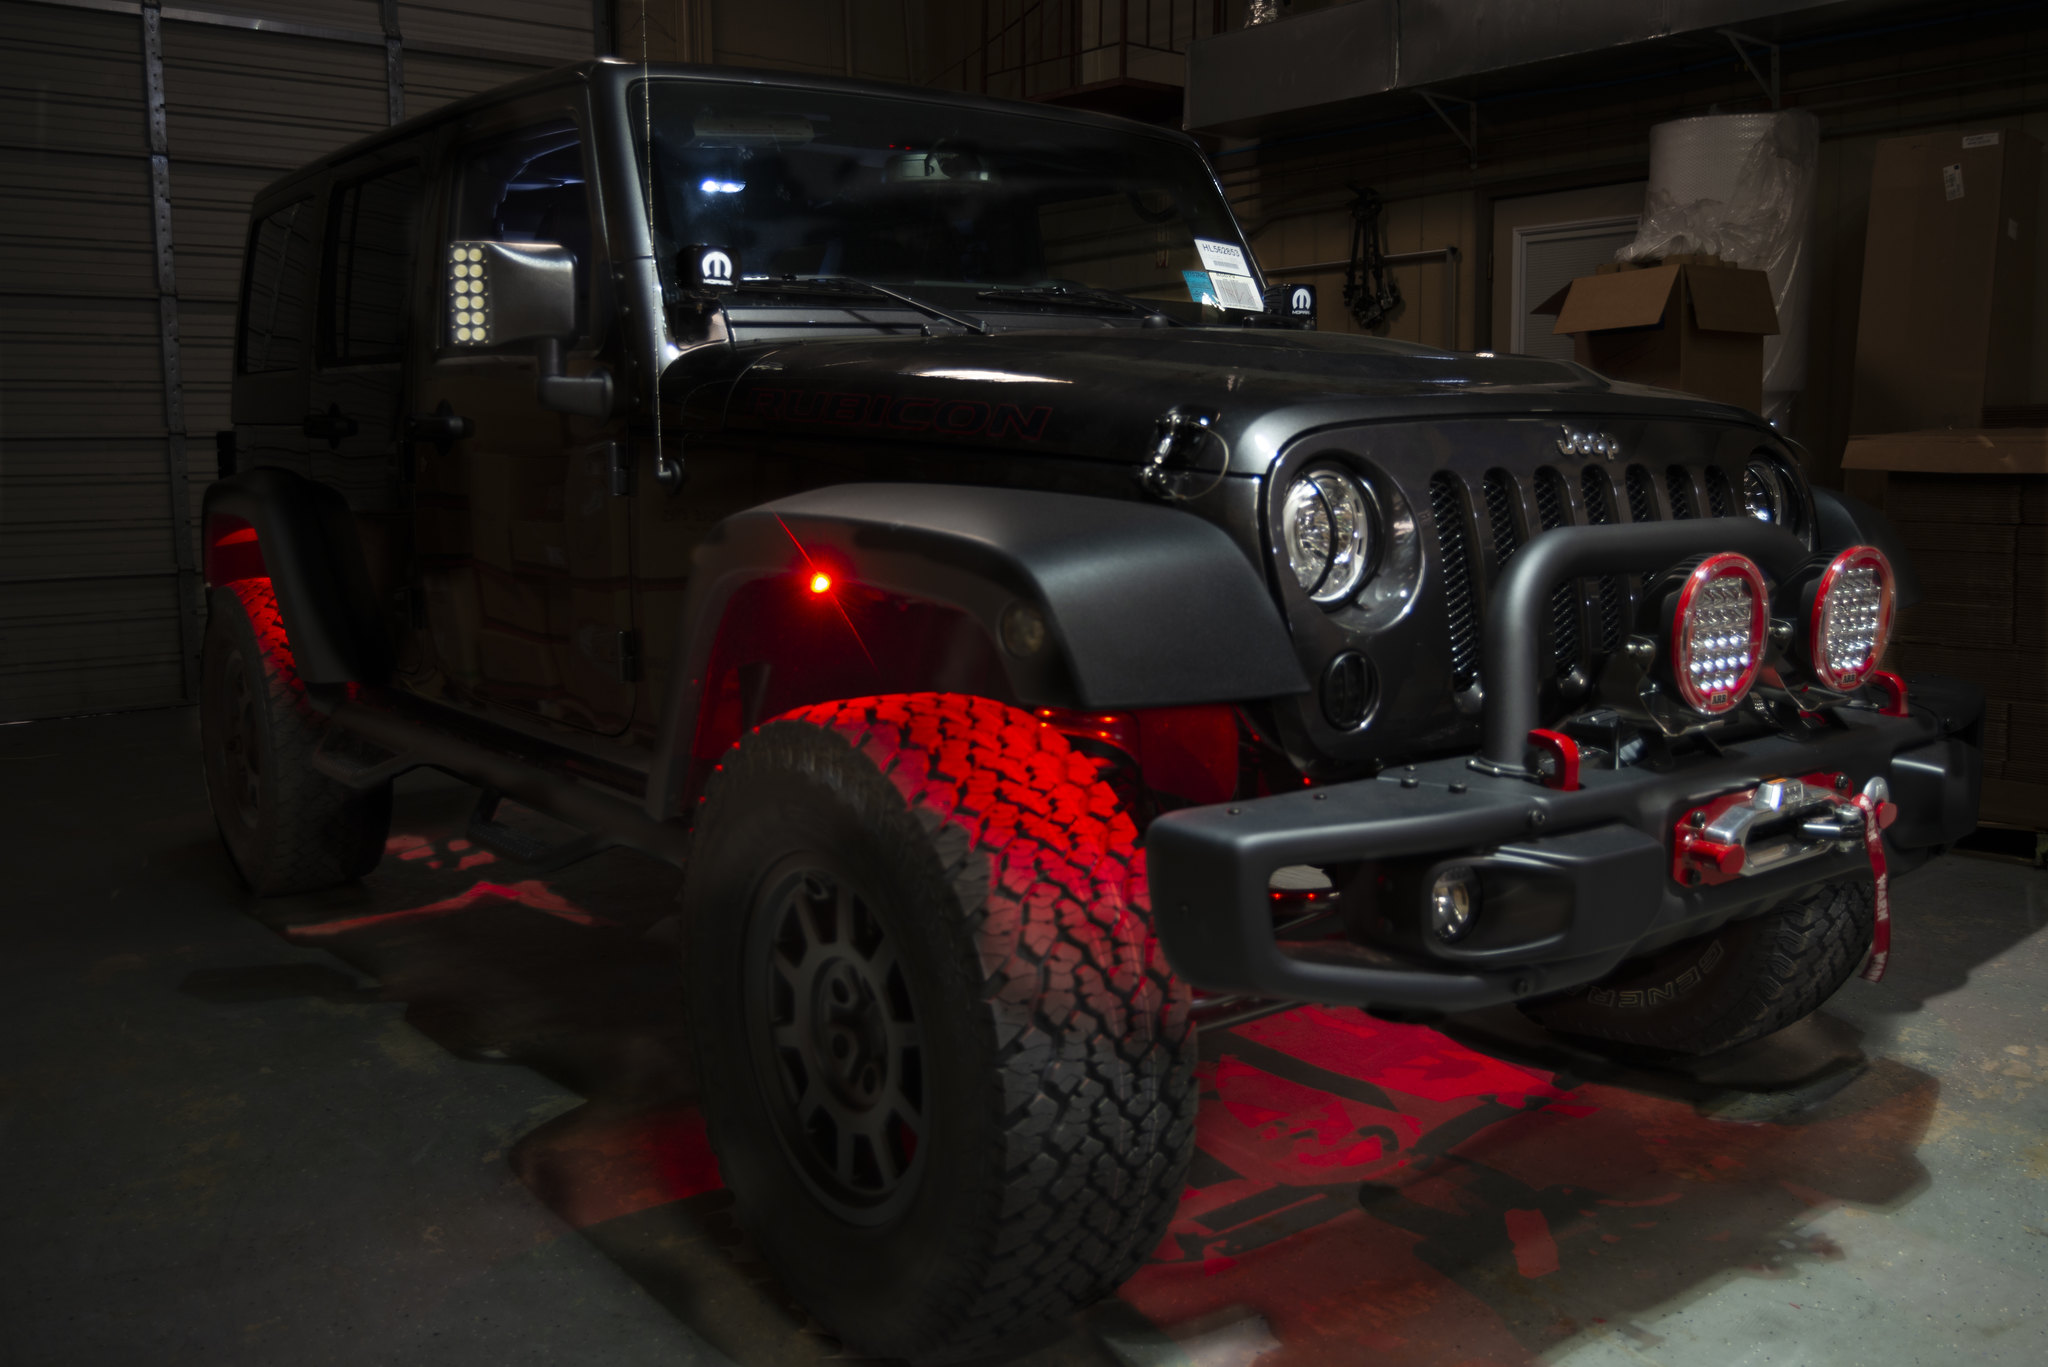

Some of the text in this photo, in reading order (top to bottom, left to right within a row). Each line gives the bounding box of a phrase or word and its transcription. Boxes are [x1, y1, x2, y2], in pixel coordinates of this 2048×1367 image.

[746, 387, 1054, 441] RUBICON
[1557, 424, 1620, 460] Jeep
[1876, 873, 1889, 921] WARN
